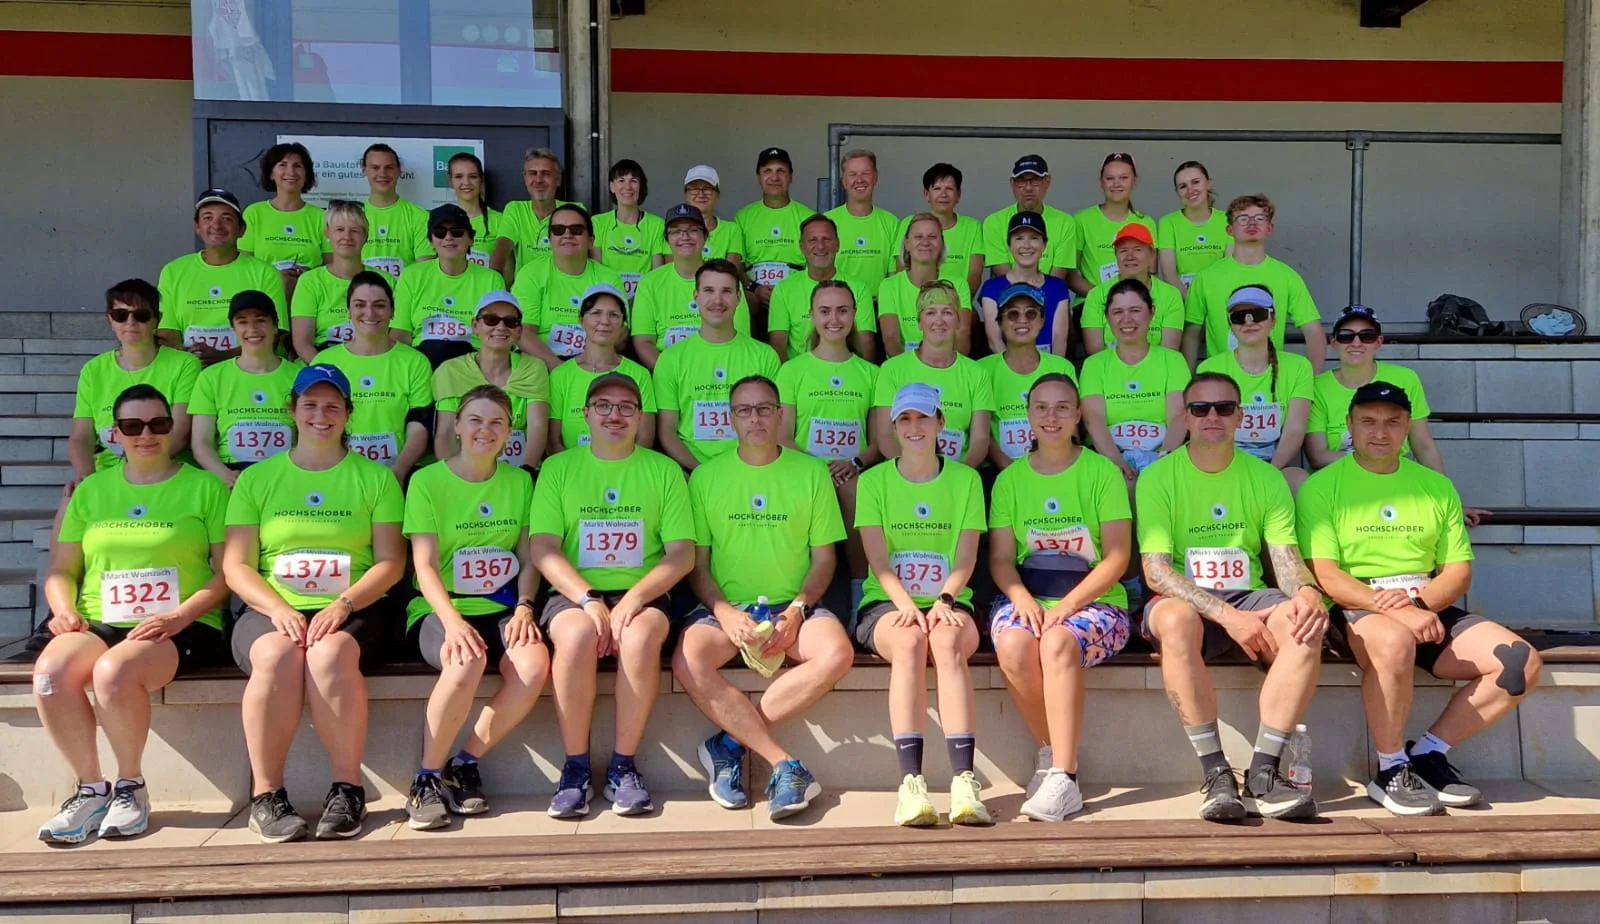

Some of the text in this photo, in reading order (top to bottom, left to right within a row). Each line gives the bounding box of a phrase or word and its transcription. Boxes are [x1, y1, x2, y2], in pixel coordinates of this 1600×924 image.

[436, 160, 449, 171] Ba
[321, 171, 337, 179] ein
[400, 171, 414, 179] ühl
[755, 270, 784, 280] 1364
[428, 322, 466, 336] 1385
[554, 330, 586, 350] 138
[699, 411, 730, 426] 131
[1240, 413, 1276, 429] 314
[814, 429, 856, 445] 1326
[1114, 424, 1160, 438] 1363
[235, 431, 285, 447] 1378
[355, 444, 391, 460] 361
[728, 513, 788, 521] HOCHSCHOBER
[455, 519, 518, 531] HOCHSCHOBER
[891, 522, 952, 530] HOCHSCHOBER
[1355, 525, 1425, 533] HOCHSCHOBER
[585, 532, 638, 551] 1379
[1034, 536, 1084, 551] 1377
[106, 570, 171, 580] Markt Wolnzach
[281, 559, 341, 579] 1371
[461, 557, 513, 579] 1367
[895, 562, 942, 582] 1373
[1192, 559, 1244, 579] 1318
[110, 582, 171, 605] 1322
